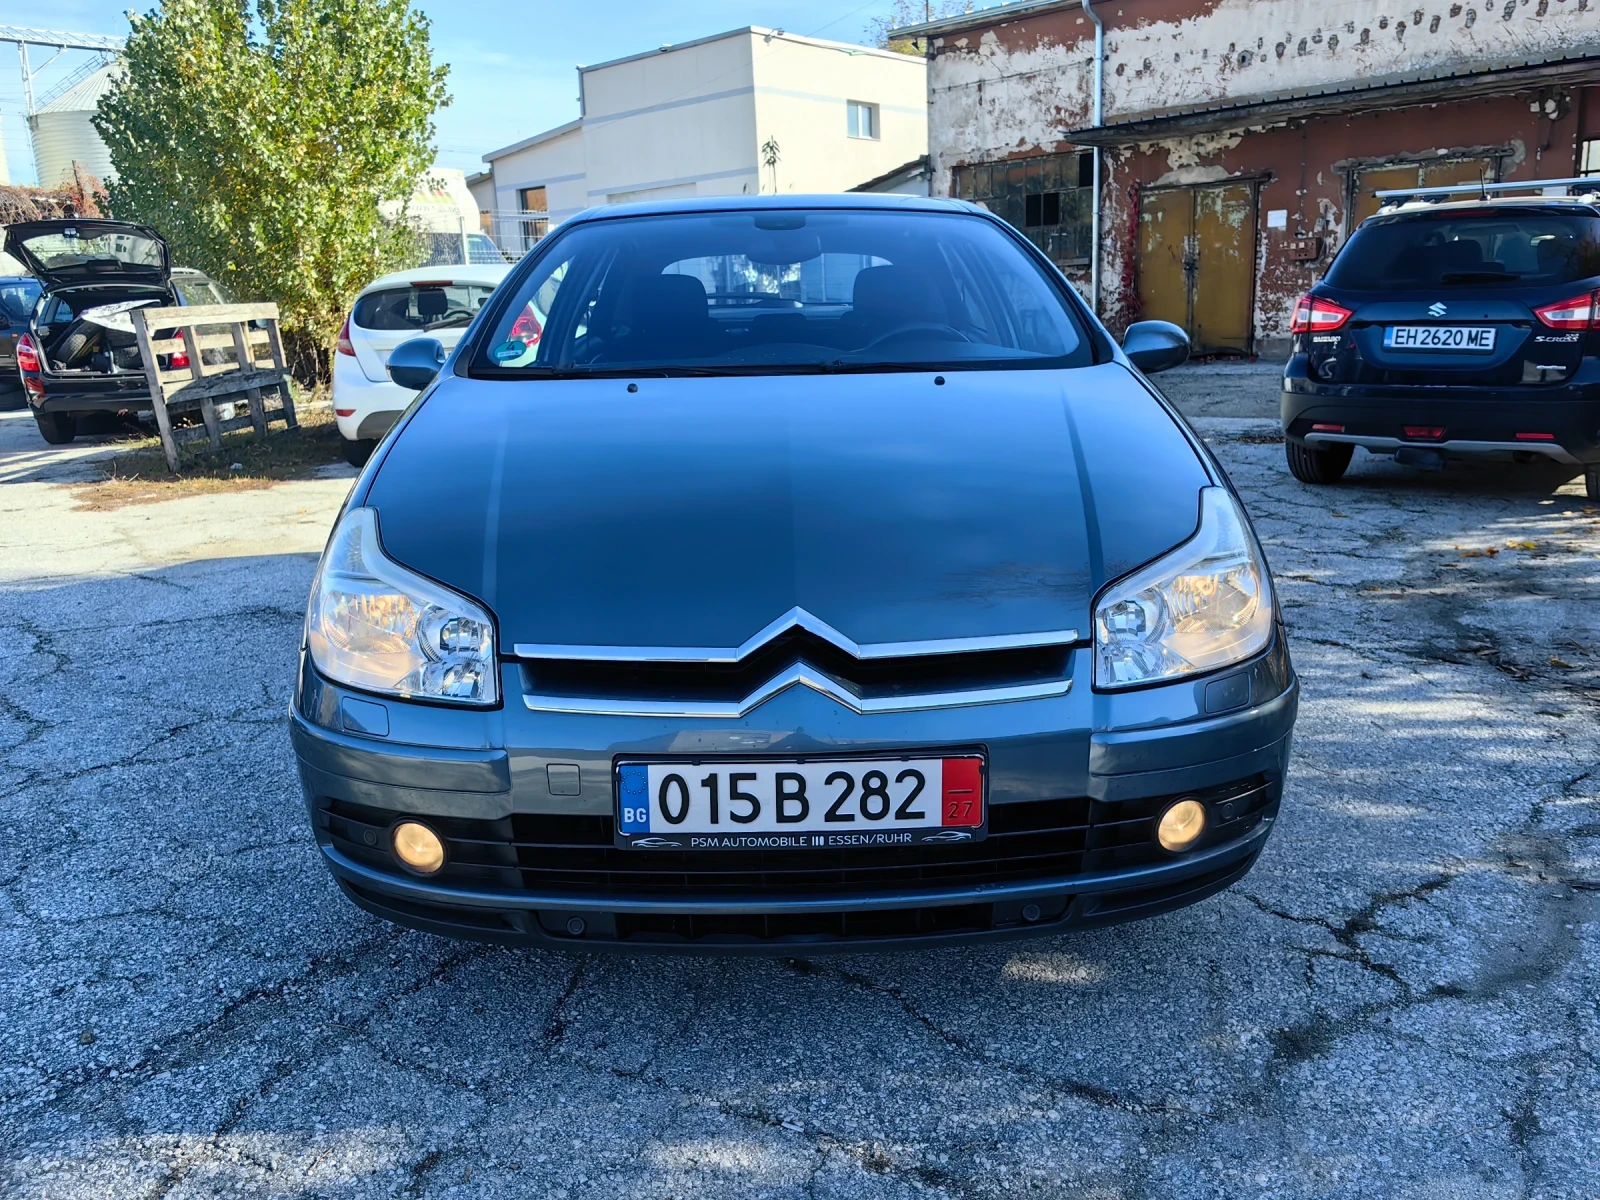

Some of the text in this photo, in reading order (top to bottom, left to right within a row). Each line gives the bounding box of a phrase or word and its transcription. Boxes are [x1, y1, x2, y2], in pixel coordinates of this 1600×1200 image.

[1394, 329, 1492, 347] EH 2620 ME
[624, 807, 647, 824] BG
[948, 801, 973, 819] 27
[691, 833, 912, 847] PSM AUTOMOBILE ESSEN/RUHR
